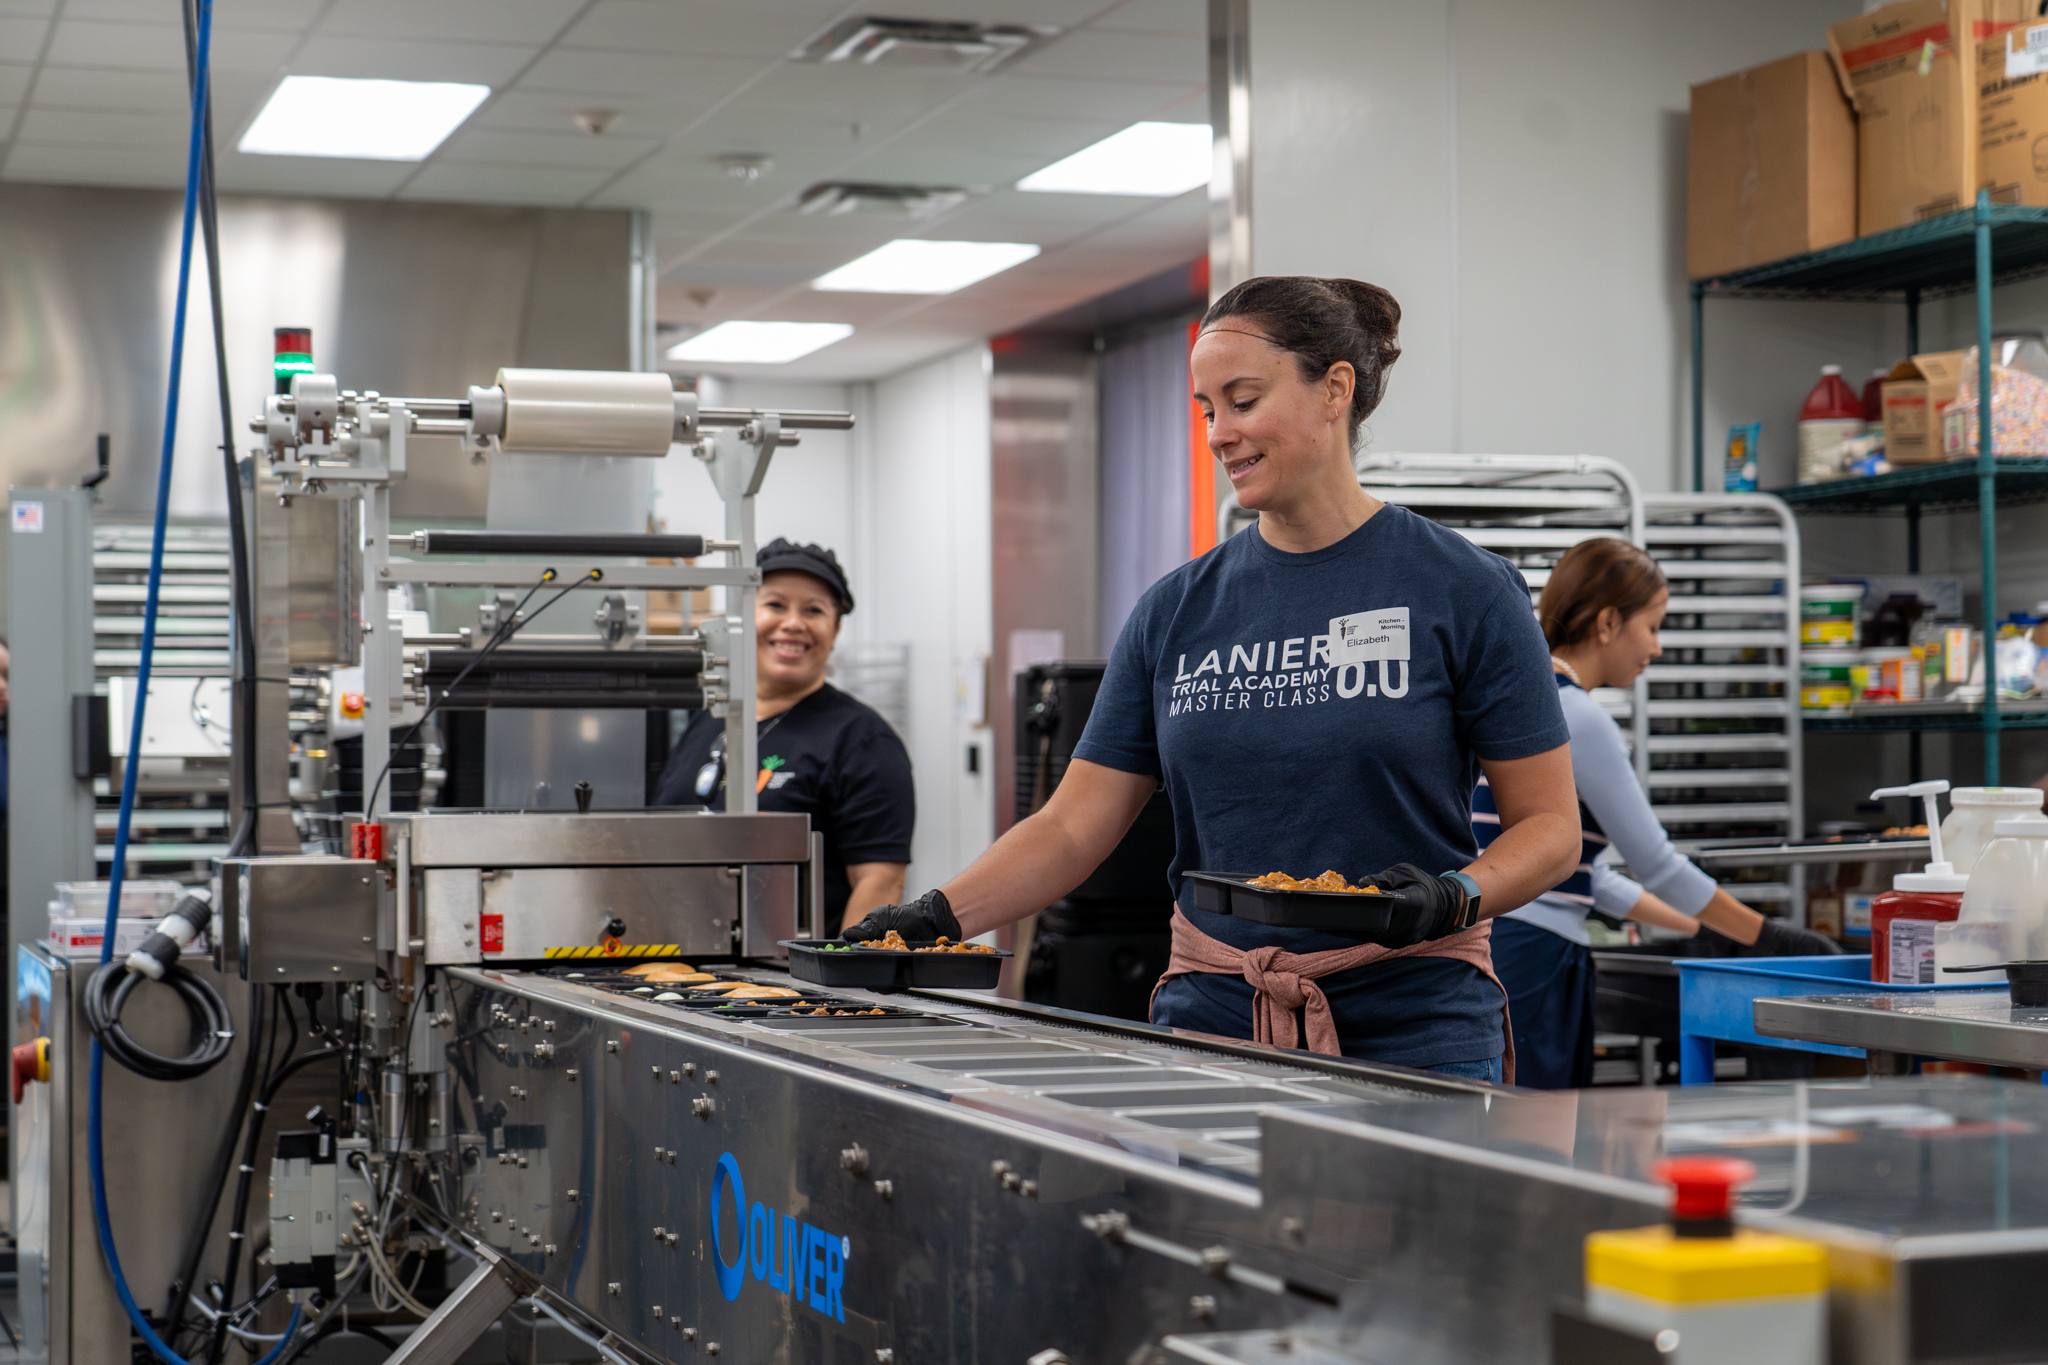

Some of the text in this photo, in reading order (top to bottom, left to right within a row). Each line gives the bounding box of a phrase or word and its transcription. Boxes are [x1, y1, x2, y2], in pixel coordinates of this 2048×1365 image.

[1346, 635, 1390, 647] Elizabeth
[1174, 635, 1330, 683] LANIER
[1172, 668, 1331, 698] TRIAL ACADEMY
[1169, 684, 1330, 718] MASTER CLASS
